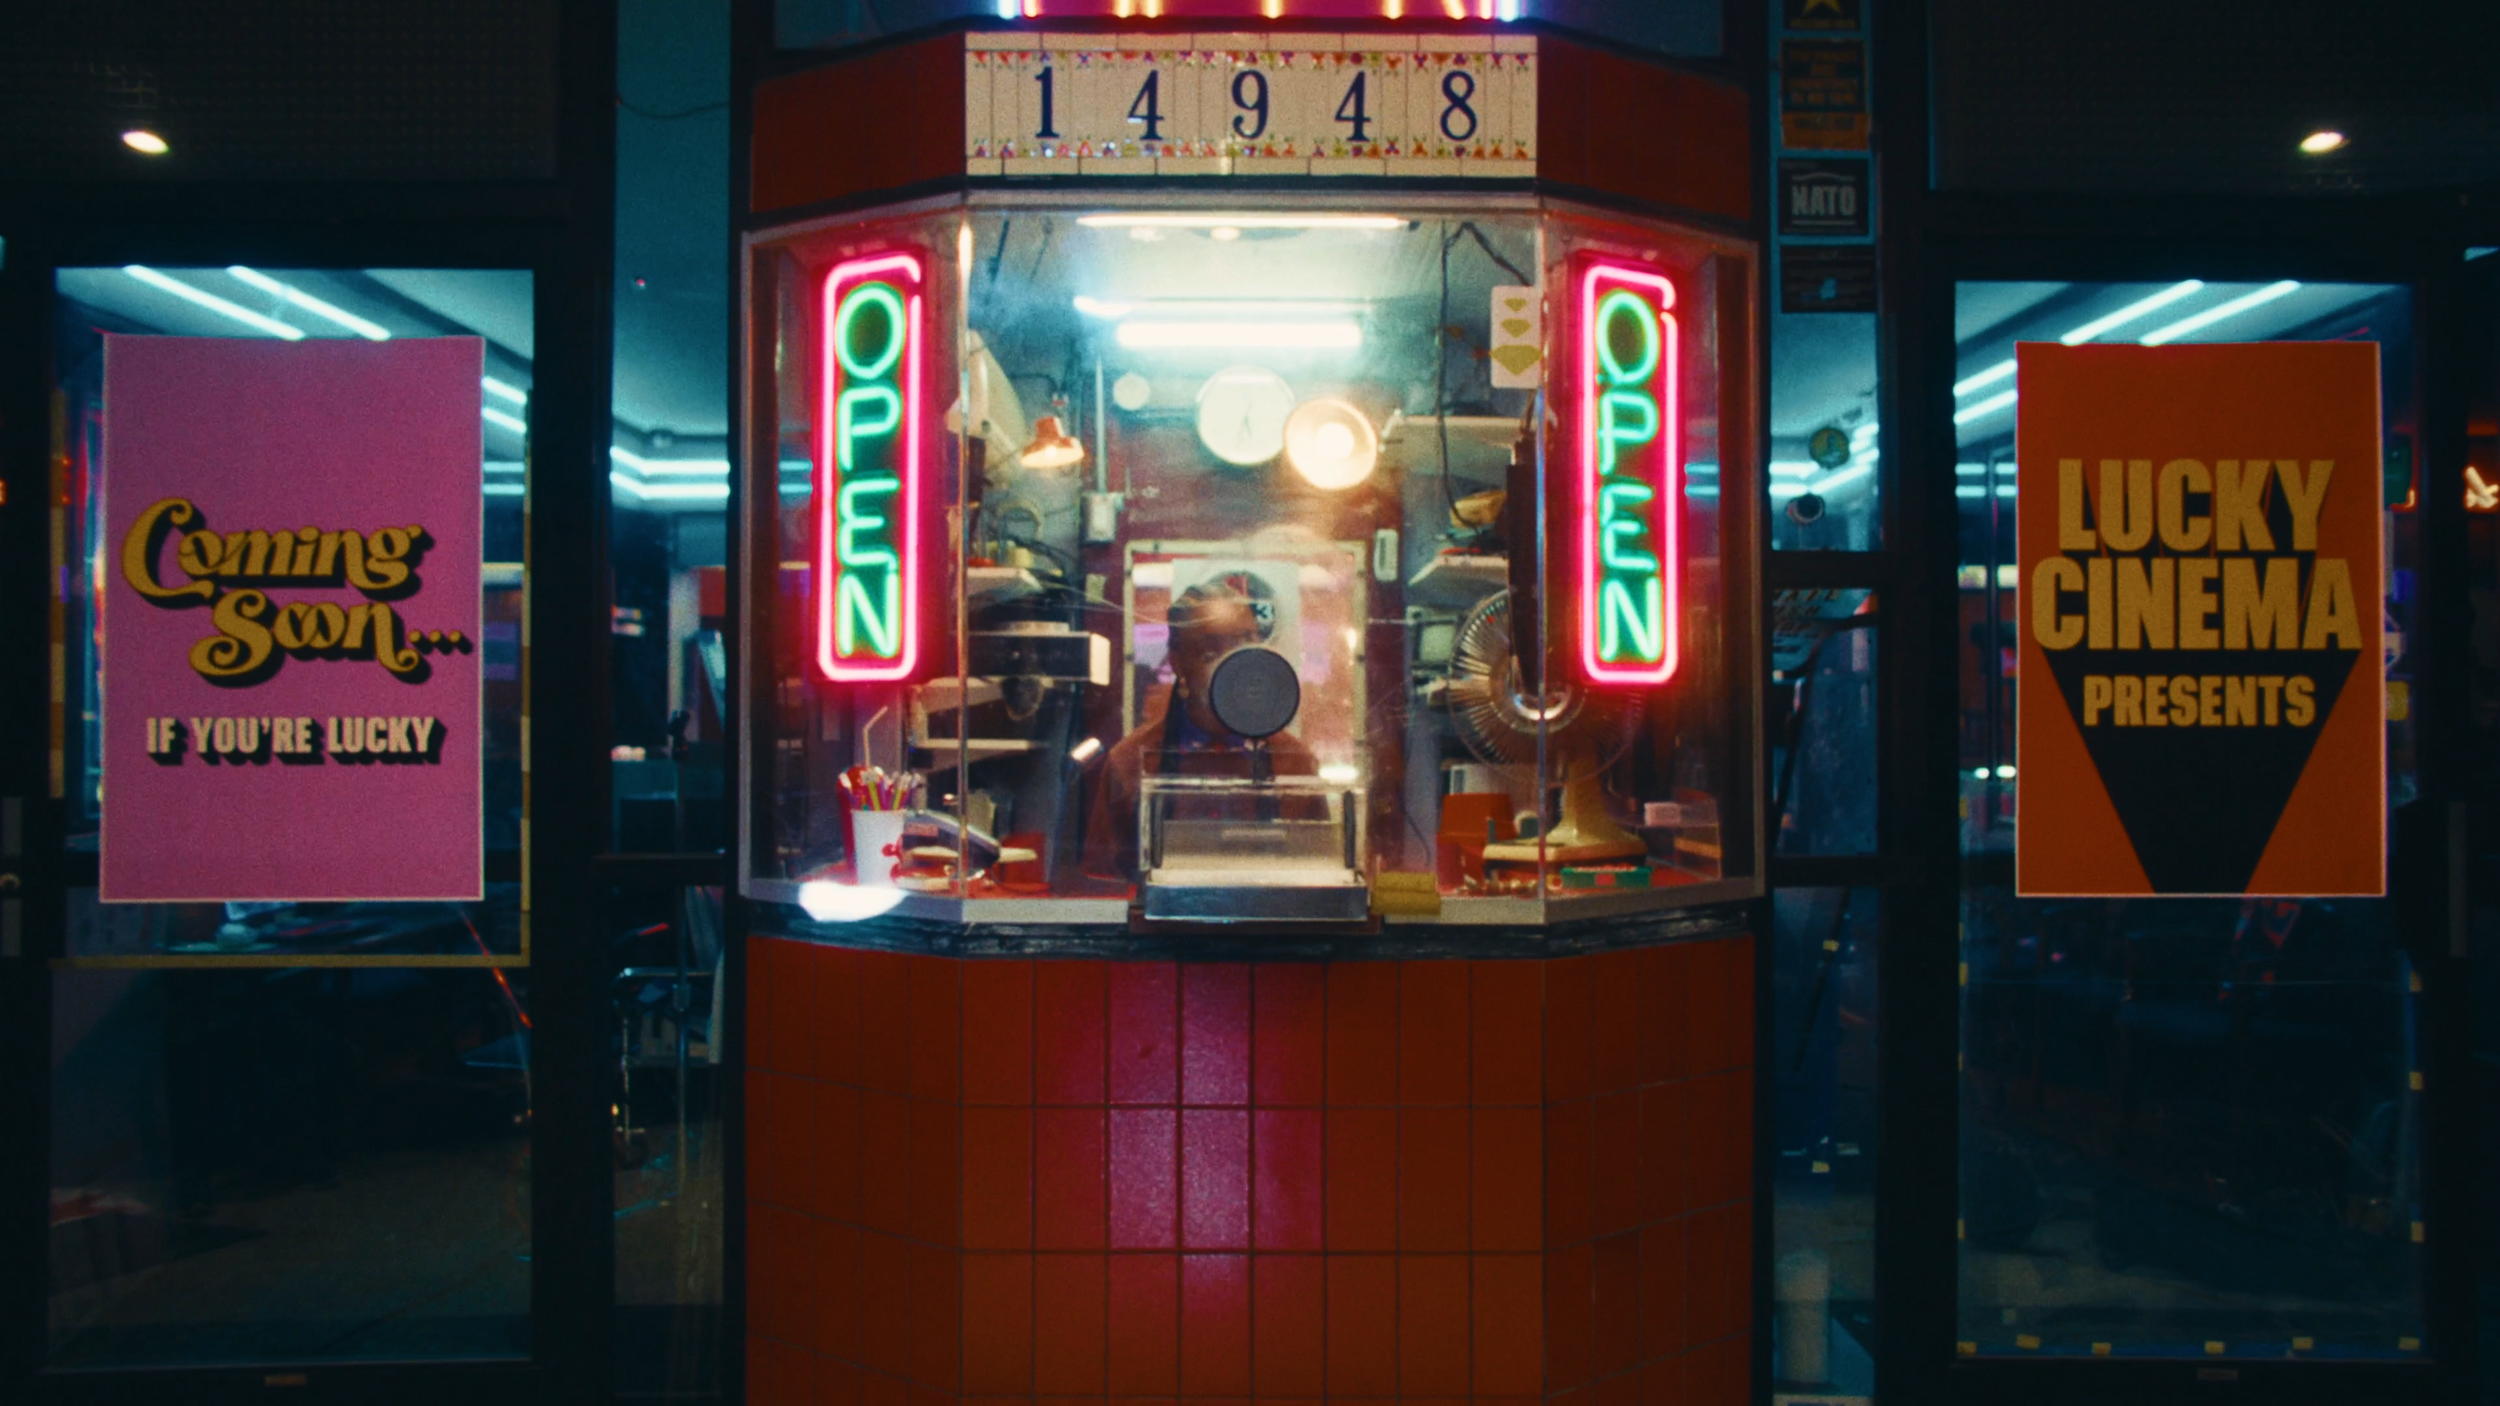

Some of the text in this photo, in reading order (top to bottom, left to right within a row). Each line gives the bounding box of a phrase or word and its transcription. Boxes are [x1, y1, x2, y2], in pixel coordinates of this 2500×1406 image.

[1790, 184, 1857, 216] NATO
[835, 283, 904, 658] OPEN
[1597, 290, 1661, 662] OPEN
[2058, 458, 2336, 551] LUCKY
[120, 497, 428, 602] Coming
[188, 588, 466, 679] Soon...
[2031, 556, 2363, 651] CINEMA
[146, 716, 438, 756] IF YOU'RE LUCKY
[2083, 675, 2317, 727] PRESENTS
